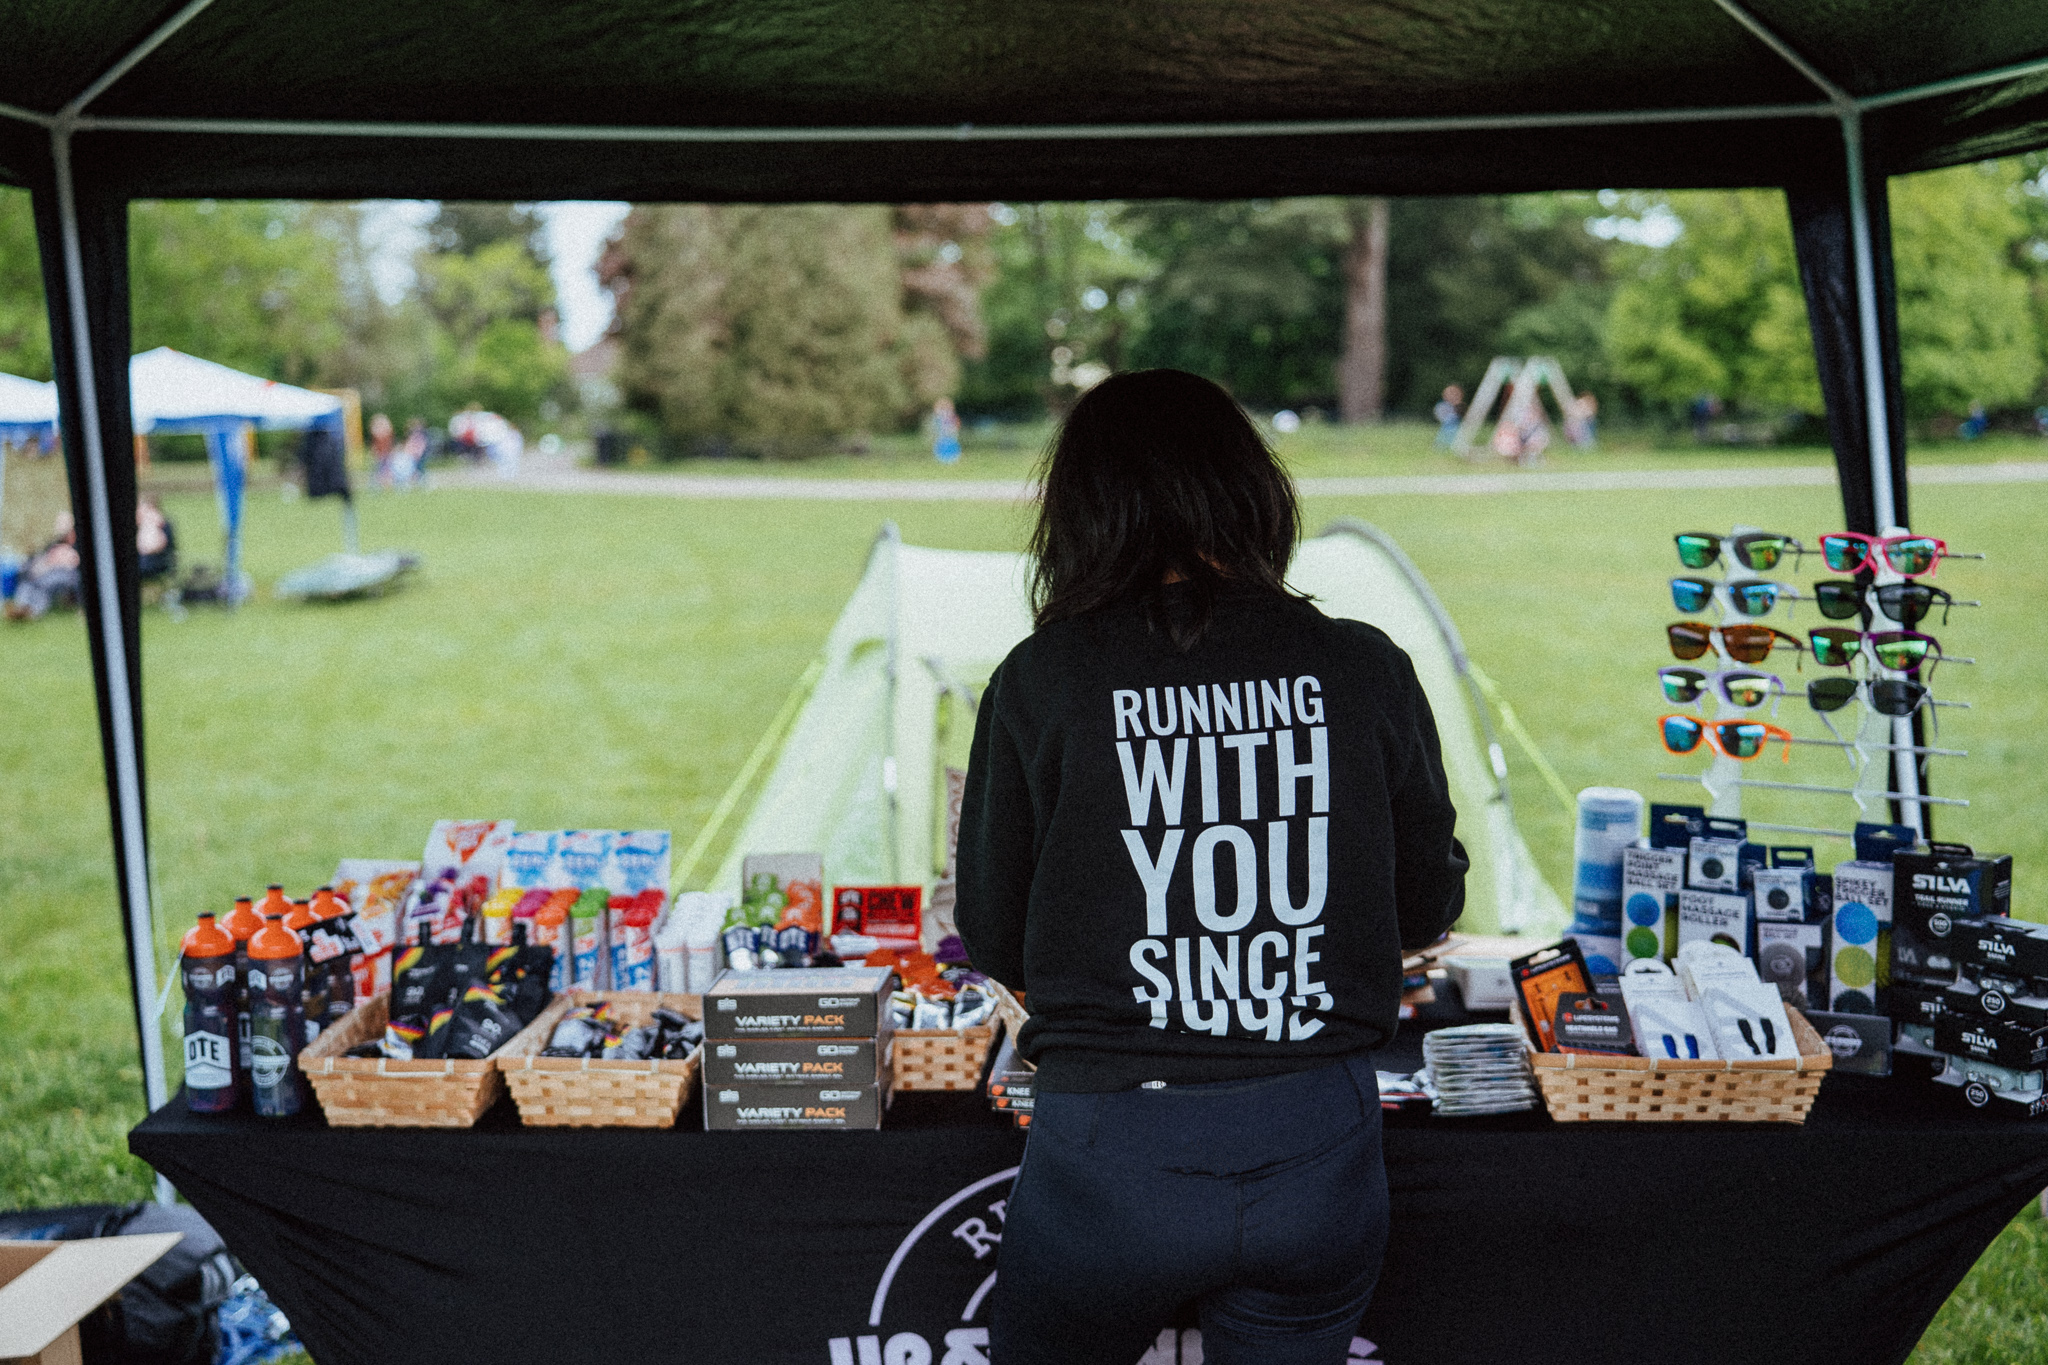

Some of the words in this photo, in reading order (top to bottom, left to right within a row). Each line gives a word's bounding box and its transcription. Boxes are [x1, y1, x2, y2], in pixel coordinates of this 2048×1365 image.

[1112, 675, 1325, 738] RUNNING
[1115, 727, 1330, 826] WITH
[1120, 816, 1329, 935] YOU
[1912, 873, 1972, 895] SILVA
[1936, 896, 1969, 907] RUNNER
[1682, 904, 1740, 918] MASSAGE
[1977, 939, 2016, 957] SILVA
[1129, 924, 1327, 1004] SINCE
[734, 1015, 801, 1027] VARIETY
[803, 1014, 845, 1026] PACK
[189, 1037, 220, 1062] OTE
[1961, 1031, 1998, 1050] SILVA
[734, 1062, 801, 1074] VARIETY
[802, 1061, 844, 1073] PACK
[1006, 1086, 1031, 1097] KNEE
[1970, 1088, 1985, 1097] 250
[736, 1107, 803, 1119] VARIETY
[804, 1106, 846, 1118] PACK
